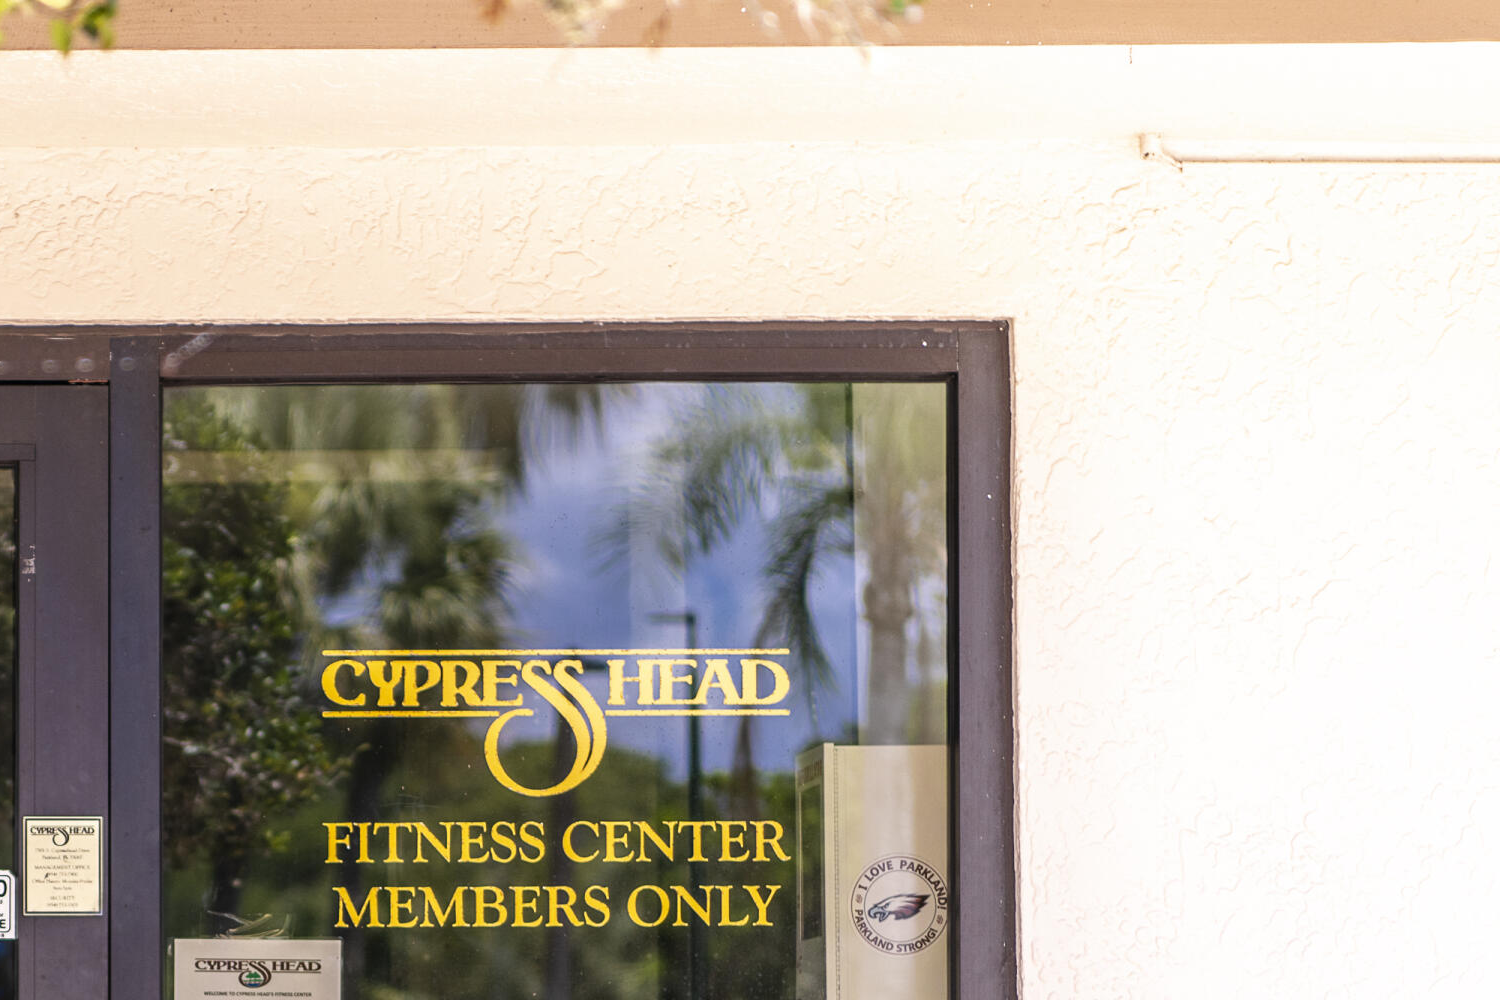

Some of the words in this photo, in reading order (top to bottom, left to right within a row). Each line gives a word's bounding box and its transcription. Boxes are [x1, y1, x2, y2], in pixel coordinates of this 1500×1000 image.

[321, 659, 607, 796] CYPRESS
[607, 659, 791, 706] HEAD
[323, 822, 545, 864] FITNESS
[563, 821, 791, 863] CENTER
[865, 860, 893, 882] LOVE
[332, 886, 610, 928] MEMBERS
[628, 885, 782, 927] ONLY
[854, 909, 894, 951] PARKLAND
[272, 960, 322, 971] HEAD
